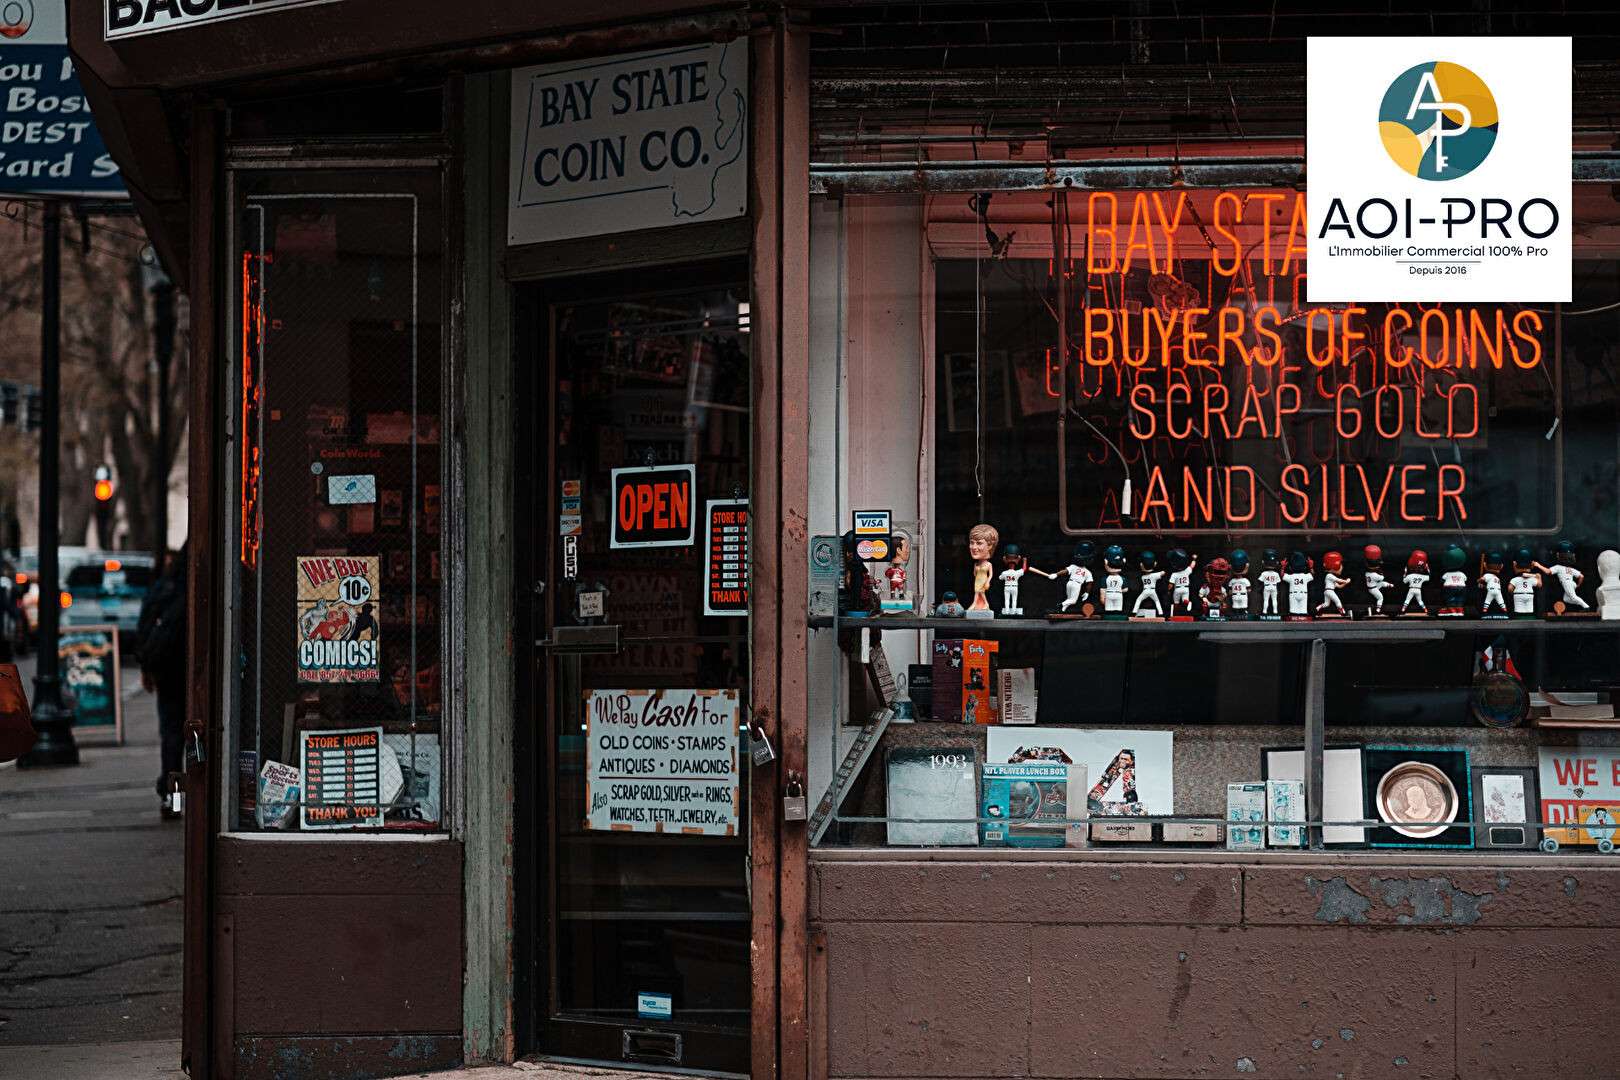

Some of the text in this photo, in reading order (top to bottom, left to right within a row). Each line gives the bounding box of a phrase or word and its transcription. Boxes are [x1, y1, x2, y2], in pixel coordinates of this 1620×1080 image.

[0, 57, 42, 81] ou
[540, 61, 710, 128] BAY STATE
[533, 125, 710, 187] COIN CO.
[1086, 191, 1189, 277] BAY
[1084, 307, 1544, 369] BUYERS OF COINS
[1129, 382, 1479, 440] SCRAP GOLD
[1140, 463, 1469, 522] AND SILVER
[619, 482, 688, 532] OPEN
[712, 511, 735, 524] STORE
[861, 519, 884, 528] VISA
[301, 558, 369, 589] WE BUY
[712, 590, 740, 603] THANK
[301, 640, 377, 667] COMICS!
[595, 693, 728, 729] We Pay Cash For
[307, 734, 377, 748] STORE HOURS
[600, 735, 726, 751] OLD COINS STAMPS
[599, 758, 730, 774] ANTIQUES DIAMONDS
[928, 753, 967, 770] 1993
[998, 767, 1025, 776] PLAYER
[1026, 767, 1049, 776] LUNCH
[1050, 767, 1066, 776] BOX
[1553, 758, 1599, 786] WE
[611, 784, 640, 800] SCRAP
[640, 785, 662, 803] GOLD,
[663, 785, 691, 802] SILVER
[705, 786, 733, 805] RINGS,
[307, 806, 377, 820] THANK YOU
[609, 806, 648, 823] WATCHES,
[648, 807, 676, 823] TEETH,
[676, 809, 718, 826] JEWELRY,
